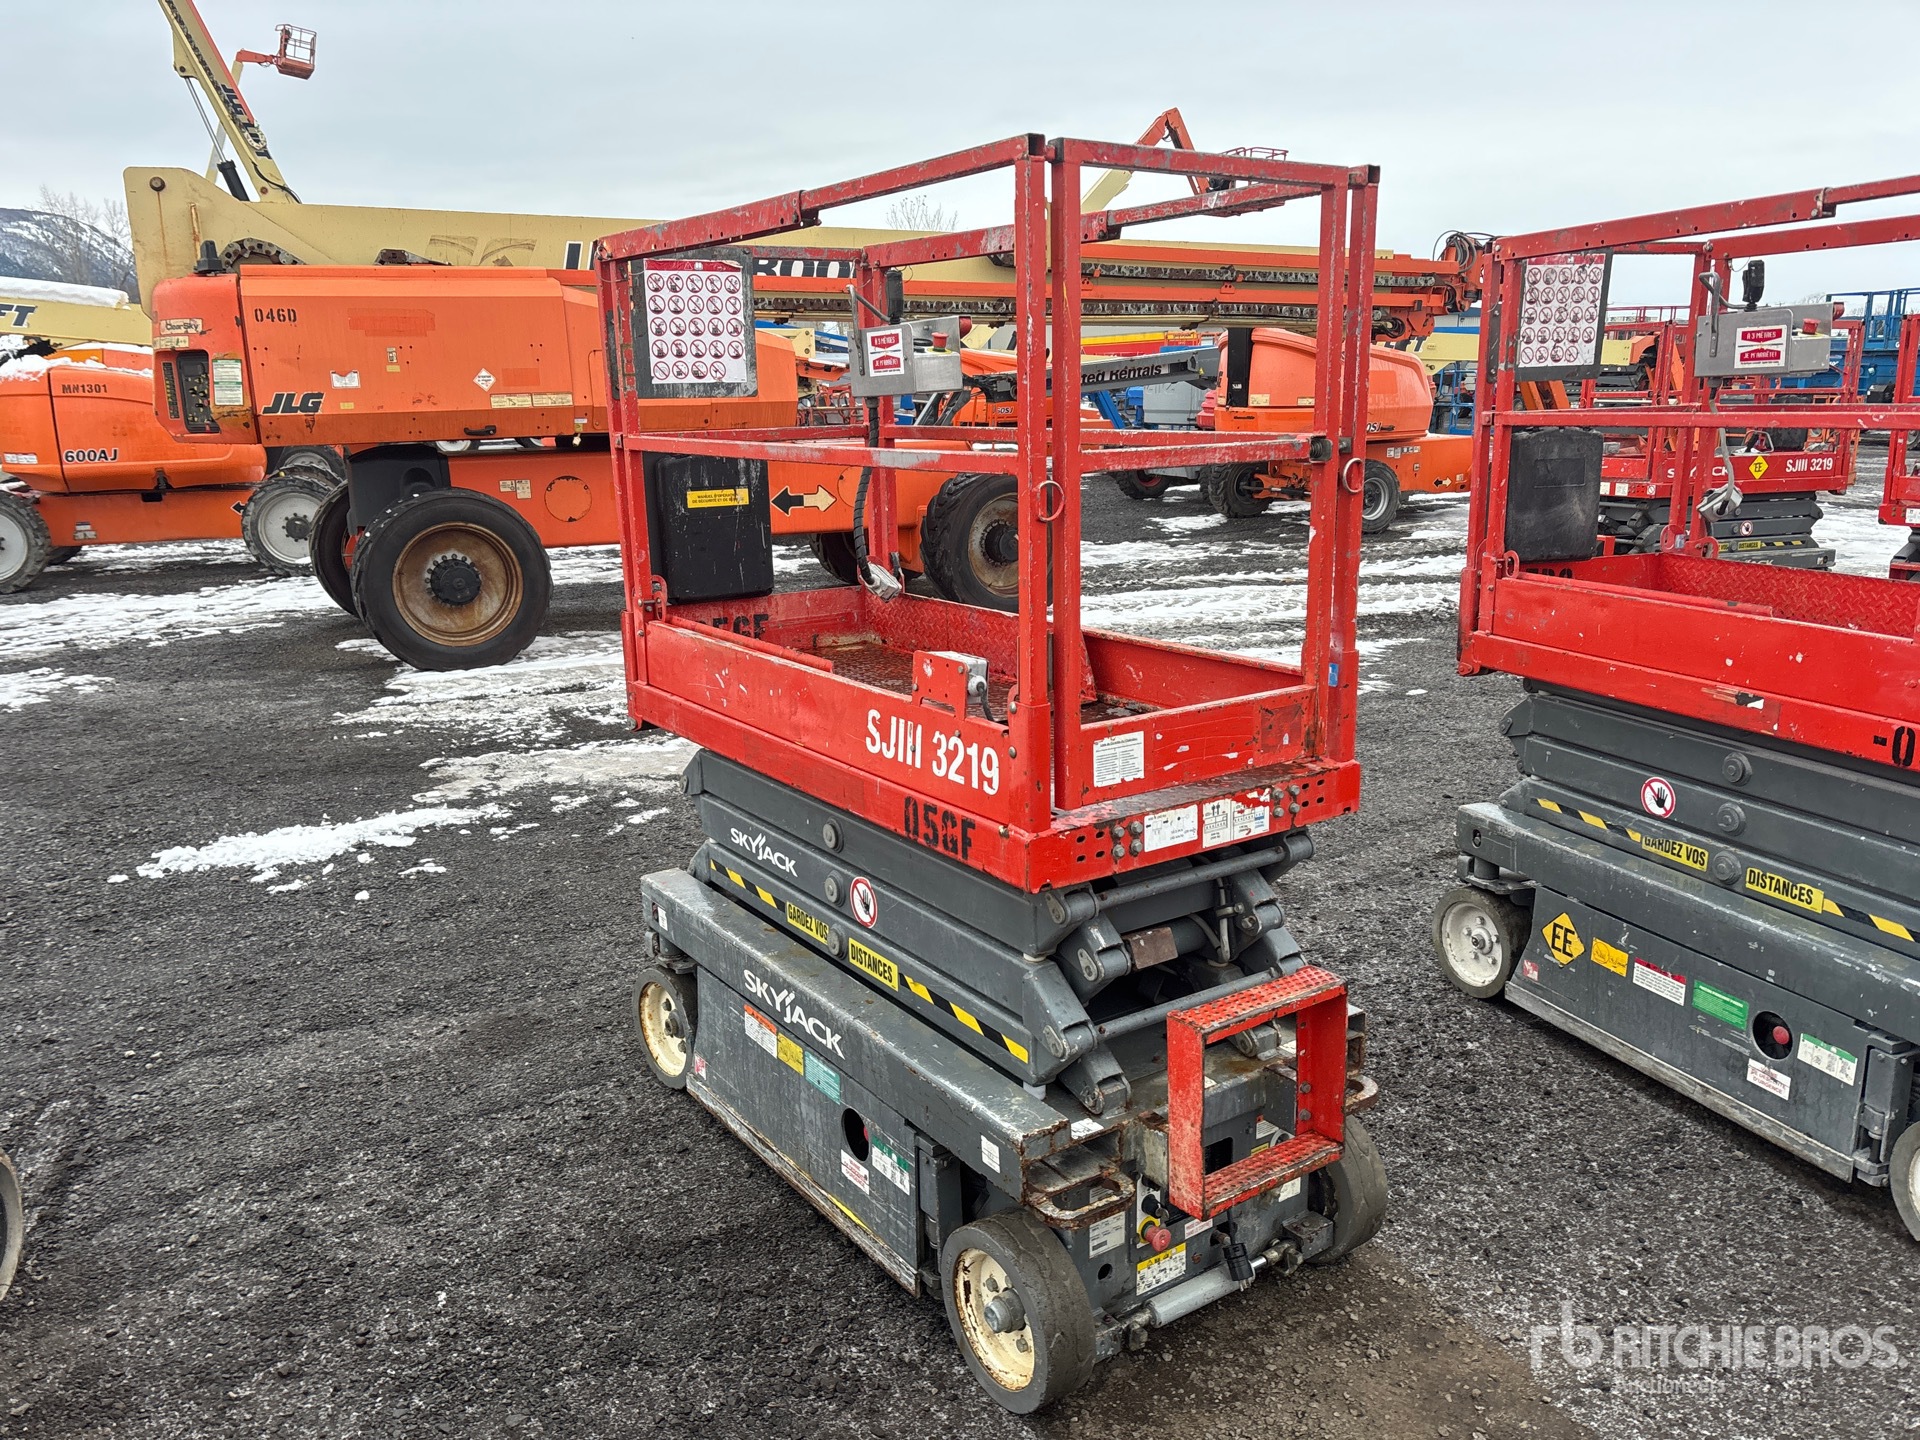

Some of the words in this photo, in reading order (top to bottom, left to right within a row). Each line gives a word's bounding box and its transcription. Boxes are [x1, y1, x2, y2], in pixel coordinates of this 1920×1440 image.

[62, 384, 108, 394] MN1301
[262, 392, 325, 414] JLG
[64, 449, 119, 463] 600AJ
[1753, 462, 1763, 473] EE
[1786, 459, 1808, 473] SJIII
[1810, 458, 1833, 471] 3219
[931, 729, 1000, 795] 3219
[730, 826, 798, 878] SKYJACK
[1645, 836, 1683, 858] GARDEZ
[1685, 846, 1706, 867] VOS
[1748, 869, 1813, 905] DISTANCES
[787, 902, 813, 935] GARDEZ
[813, 915, 829, 942] VOS
[1551, 922, 1575, 957] EE
[850, 942, 893, 983] DISTANCES
[743, 968, 846, 1060] SKYJACK
